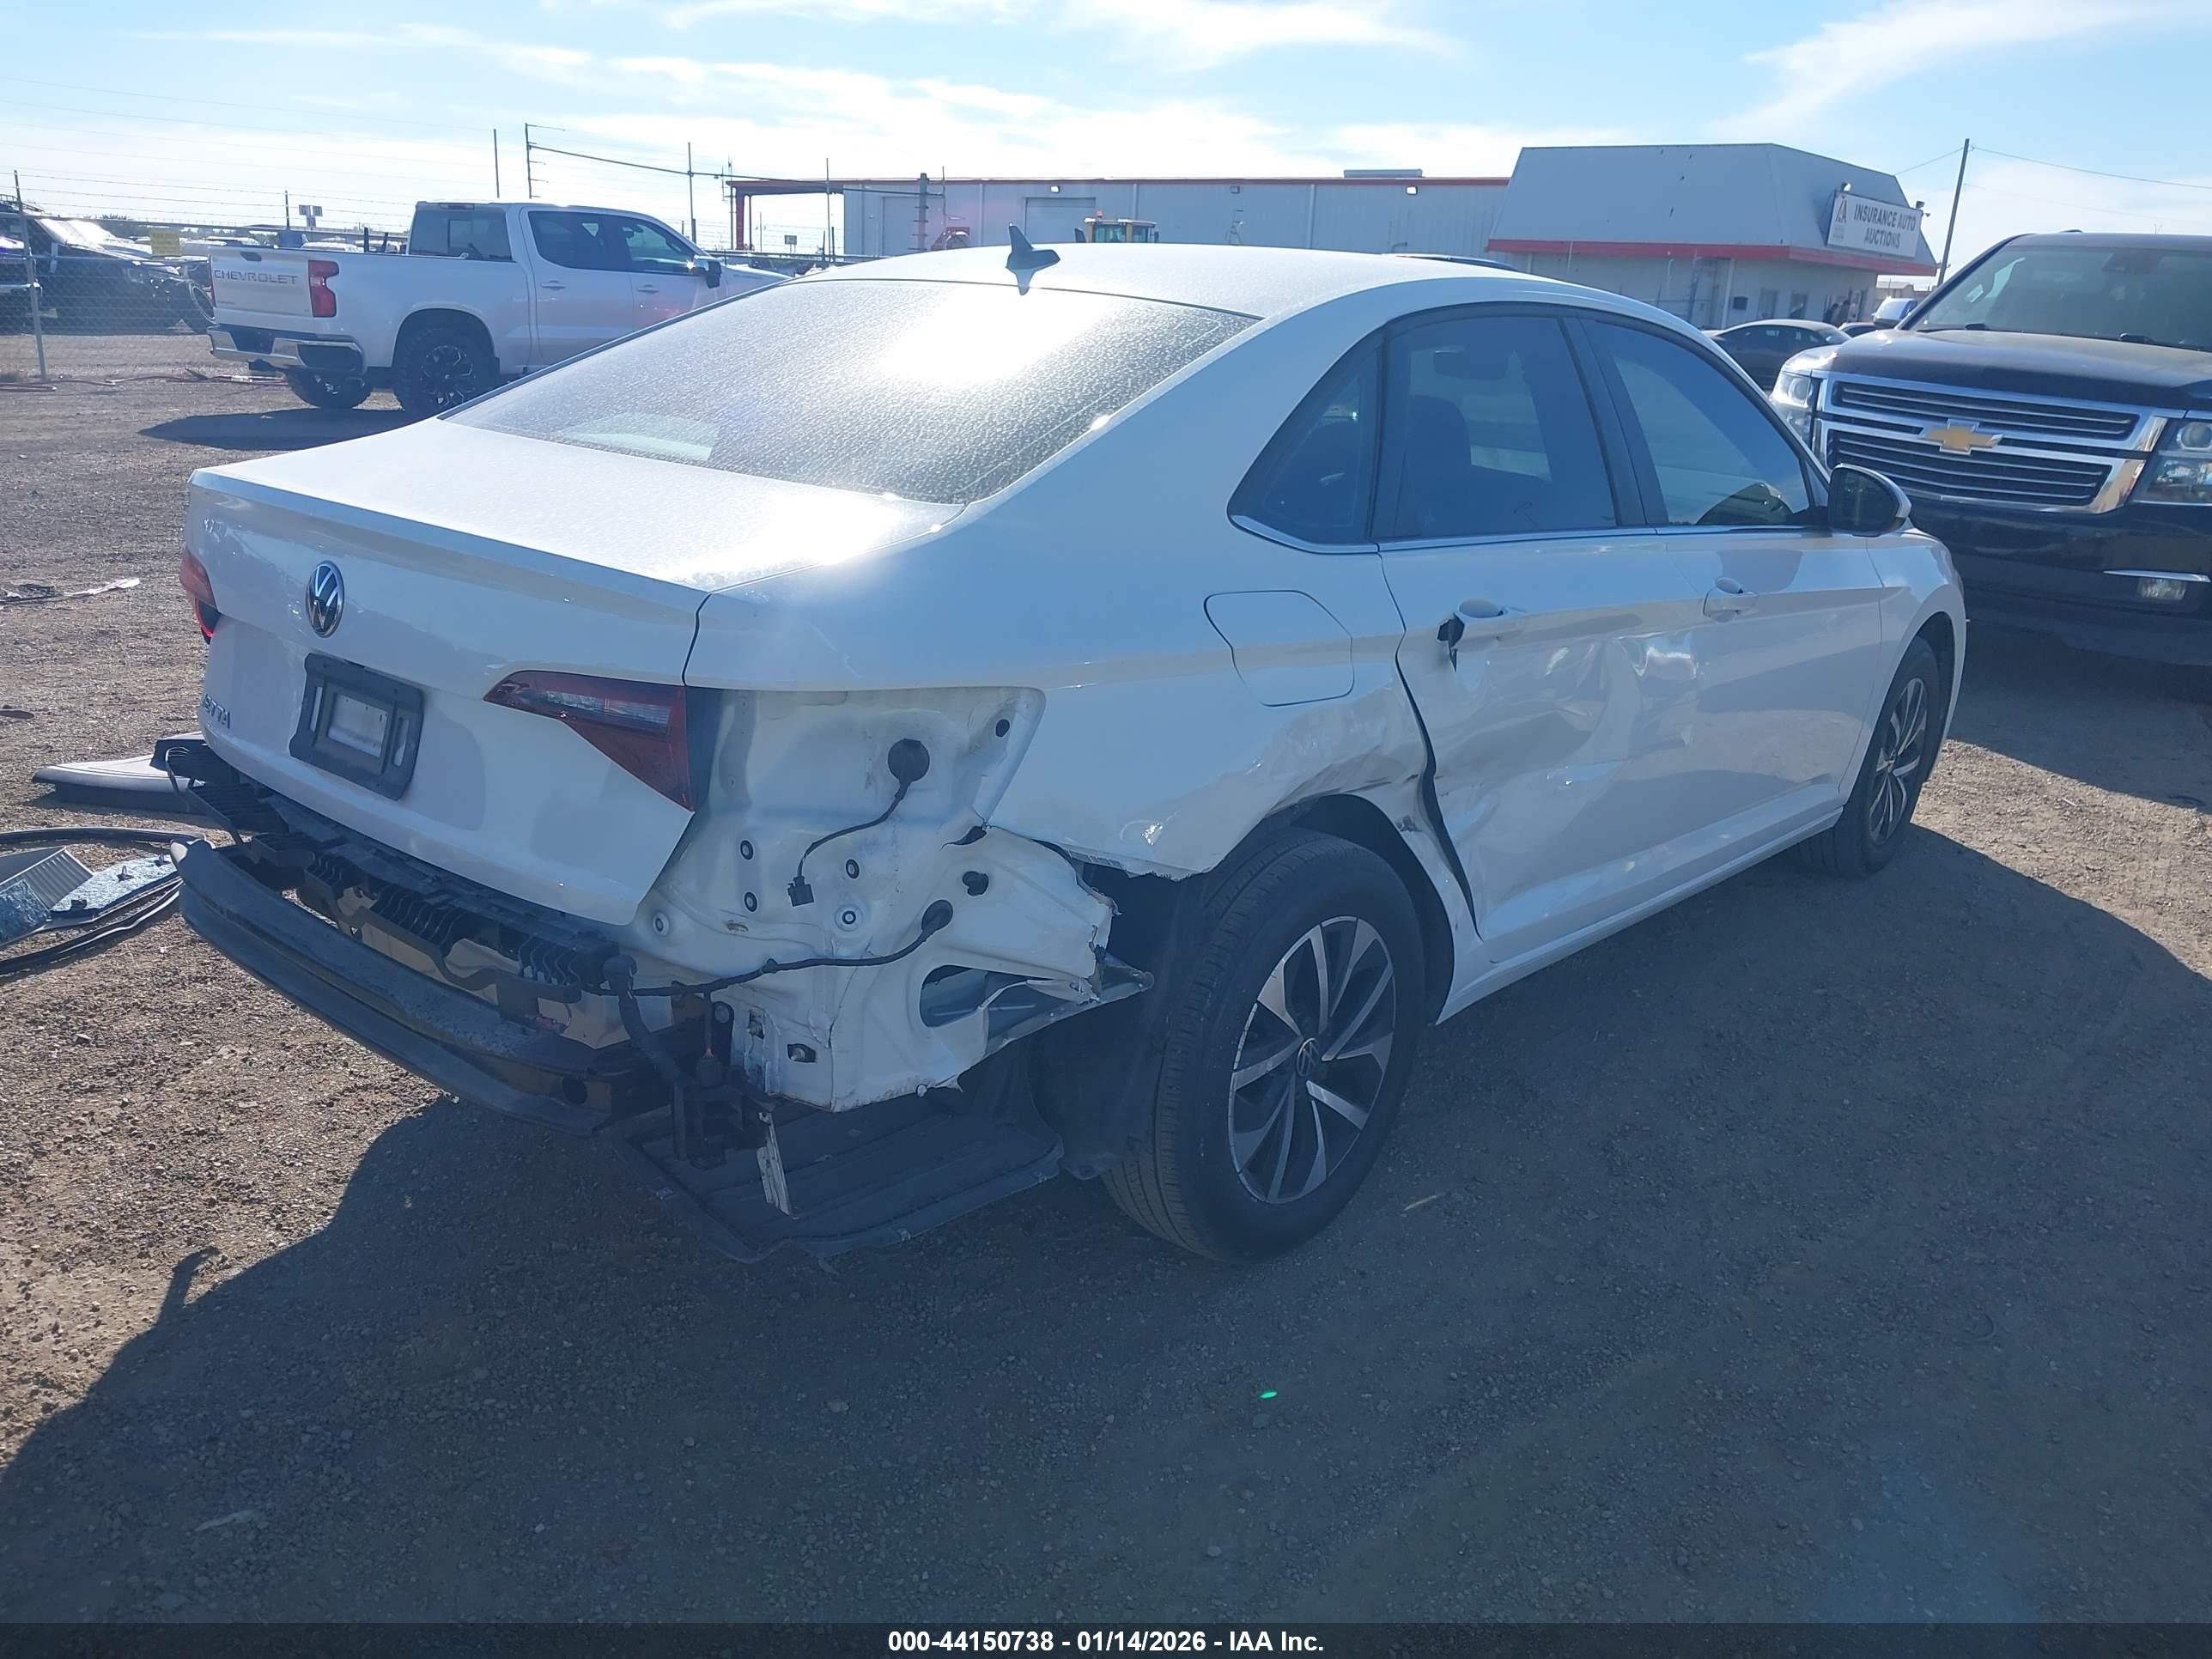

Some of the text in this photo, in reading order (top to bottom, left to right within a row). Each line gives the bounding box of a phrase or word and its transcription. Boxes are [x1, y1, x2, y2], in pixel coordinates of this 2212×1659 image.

[1853, 204, 1917, 232] INSURANCE AUTO
[1864, 227, 1901, 249] AUCTIONS
[213, 269, 298, 285] CHEVROLET
